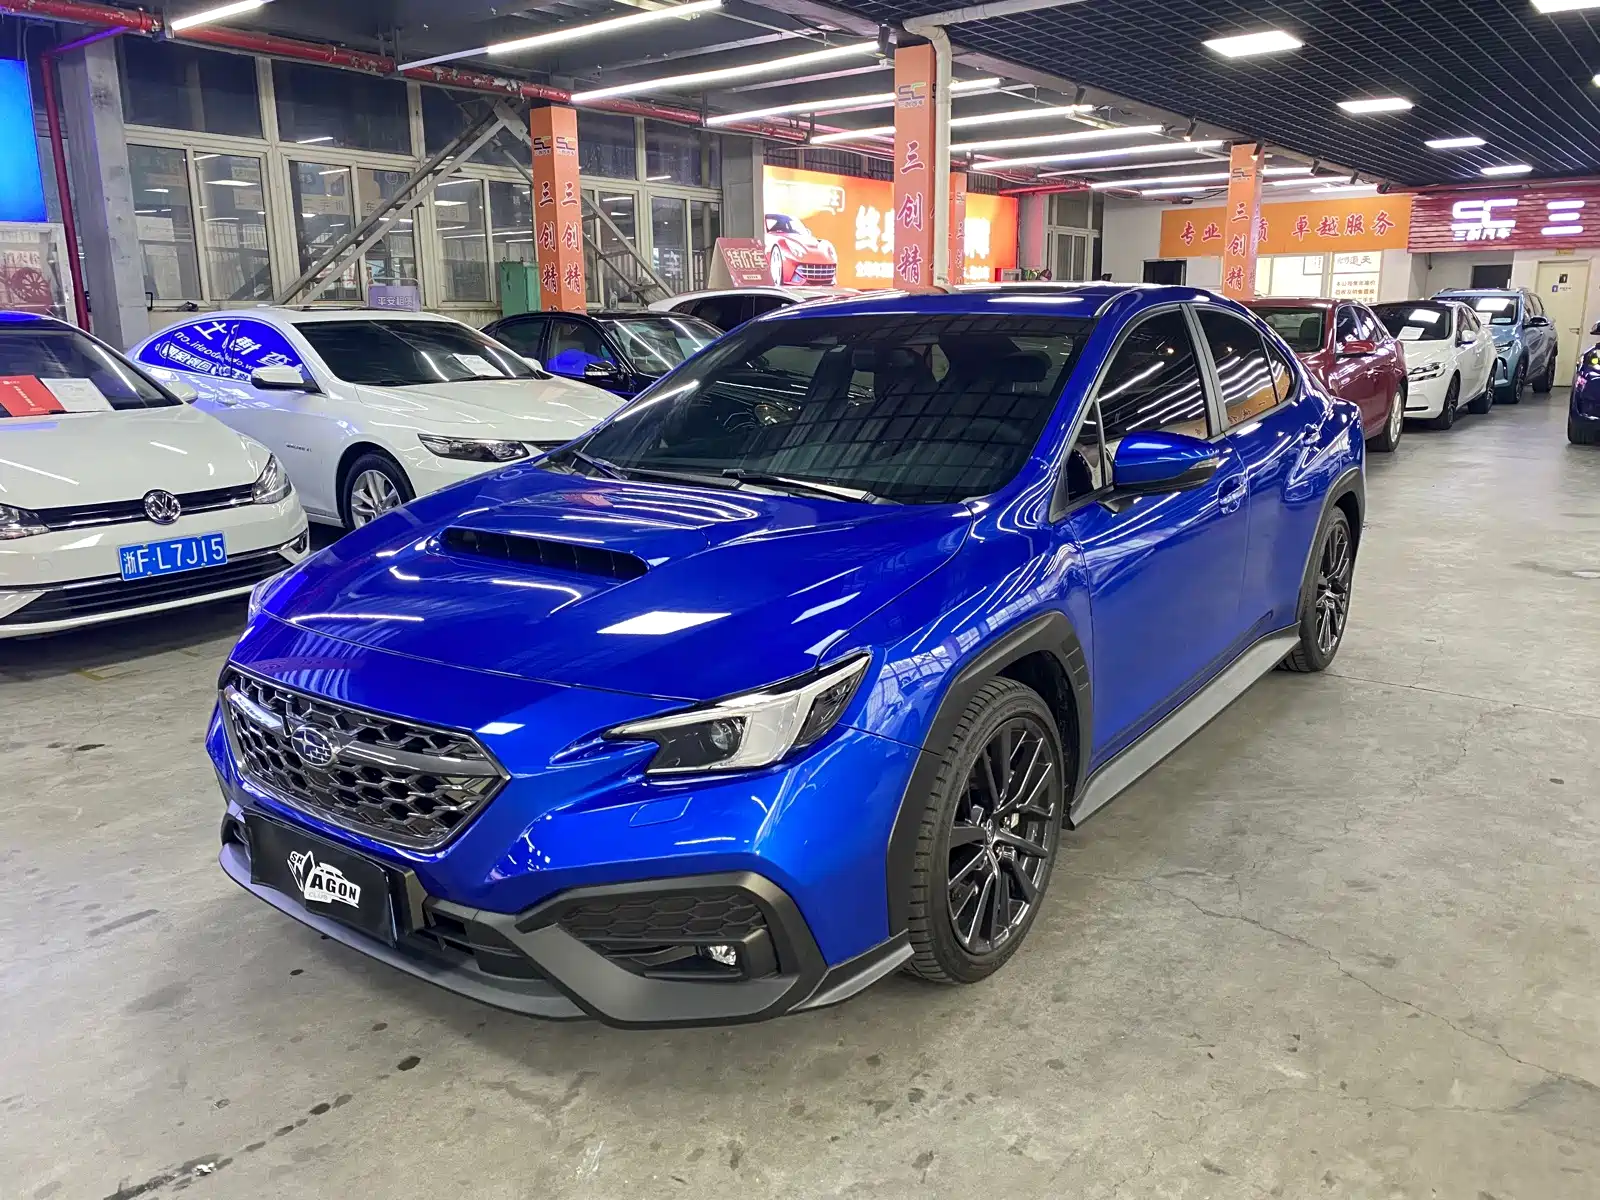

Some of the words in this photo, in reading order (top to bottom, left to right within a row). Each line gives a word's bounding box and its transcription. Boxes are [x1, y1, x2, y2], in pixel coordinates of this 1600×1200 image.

[540, 181, 558, 310] 三创精
[561, 181, 581, 310] 三创精
[724, 248, 768, 271] 特价车
[1225, 202, 1249, 290] 三创精
[1291, 210, 1395, 242] 卓越服务
